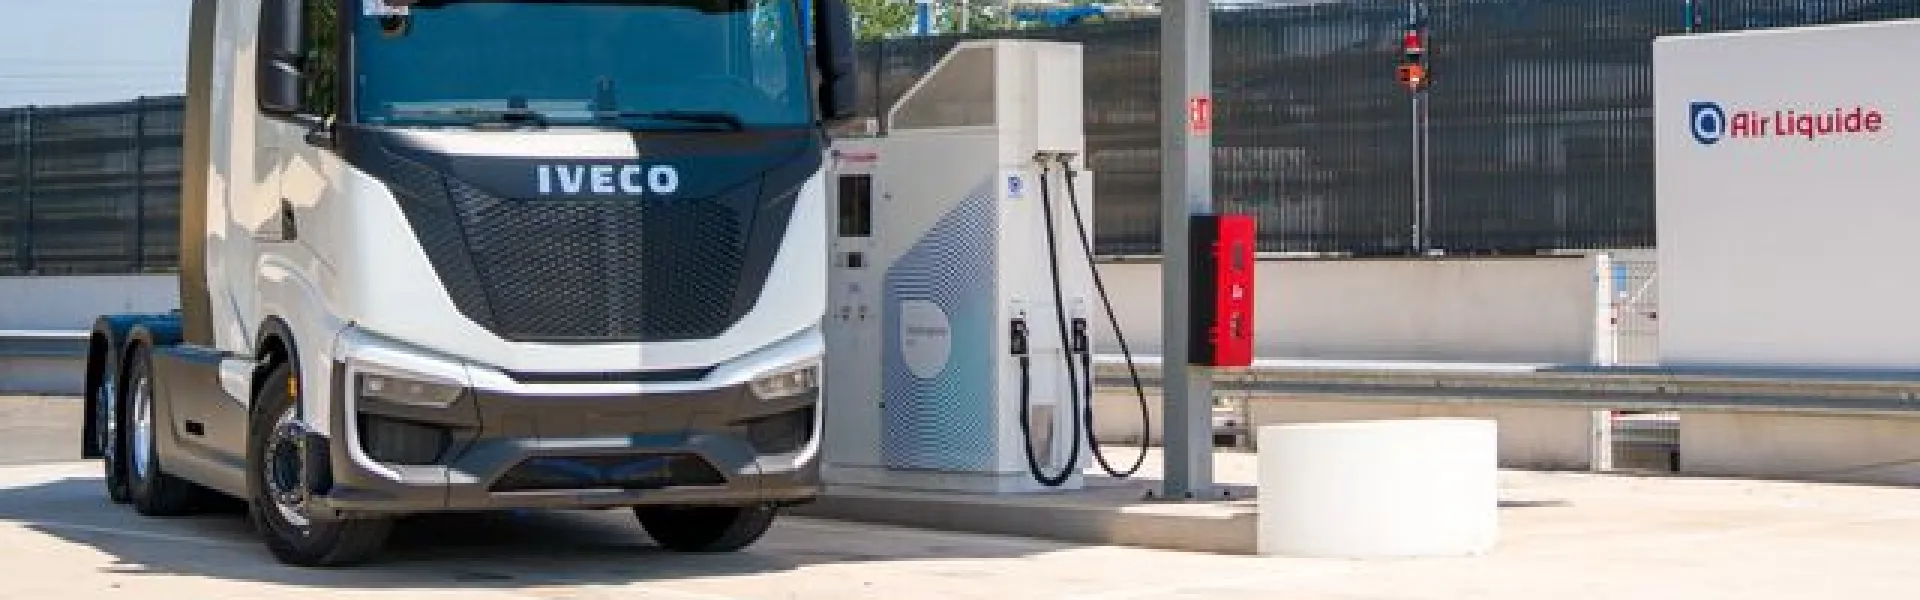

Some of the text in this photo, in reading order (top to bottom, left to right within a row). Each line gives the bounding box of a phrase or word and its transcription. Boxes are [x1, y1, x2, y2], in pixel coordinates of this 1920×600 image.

[1731, 106, 1881, 141] Air Liquide
[537, 165, 678, 195] IVECO
